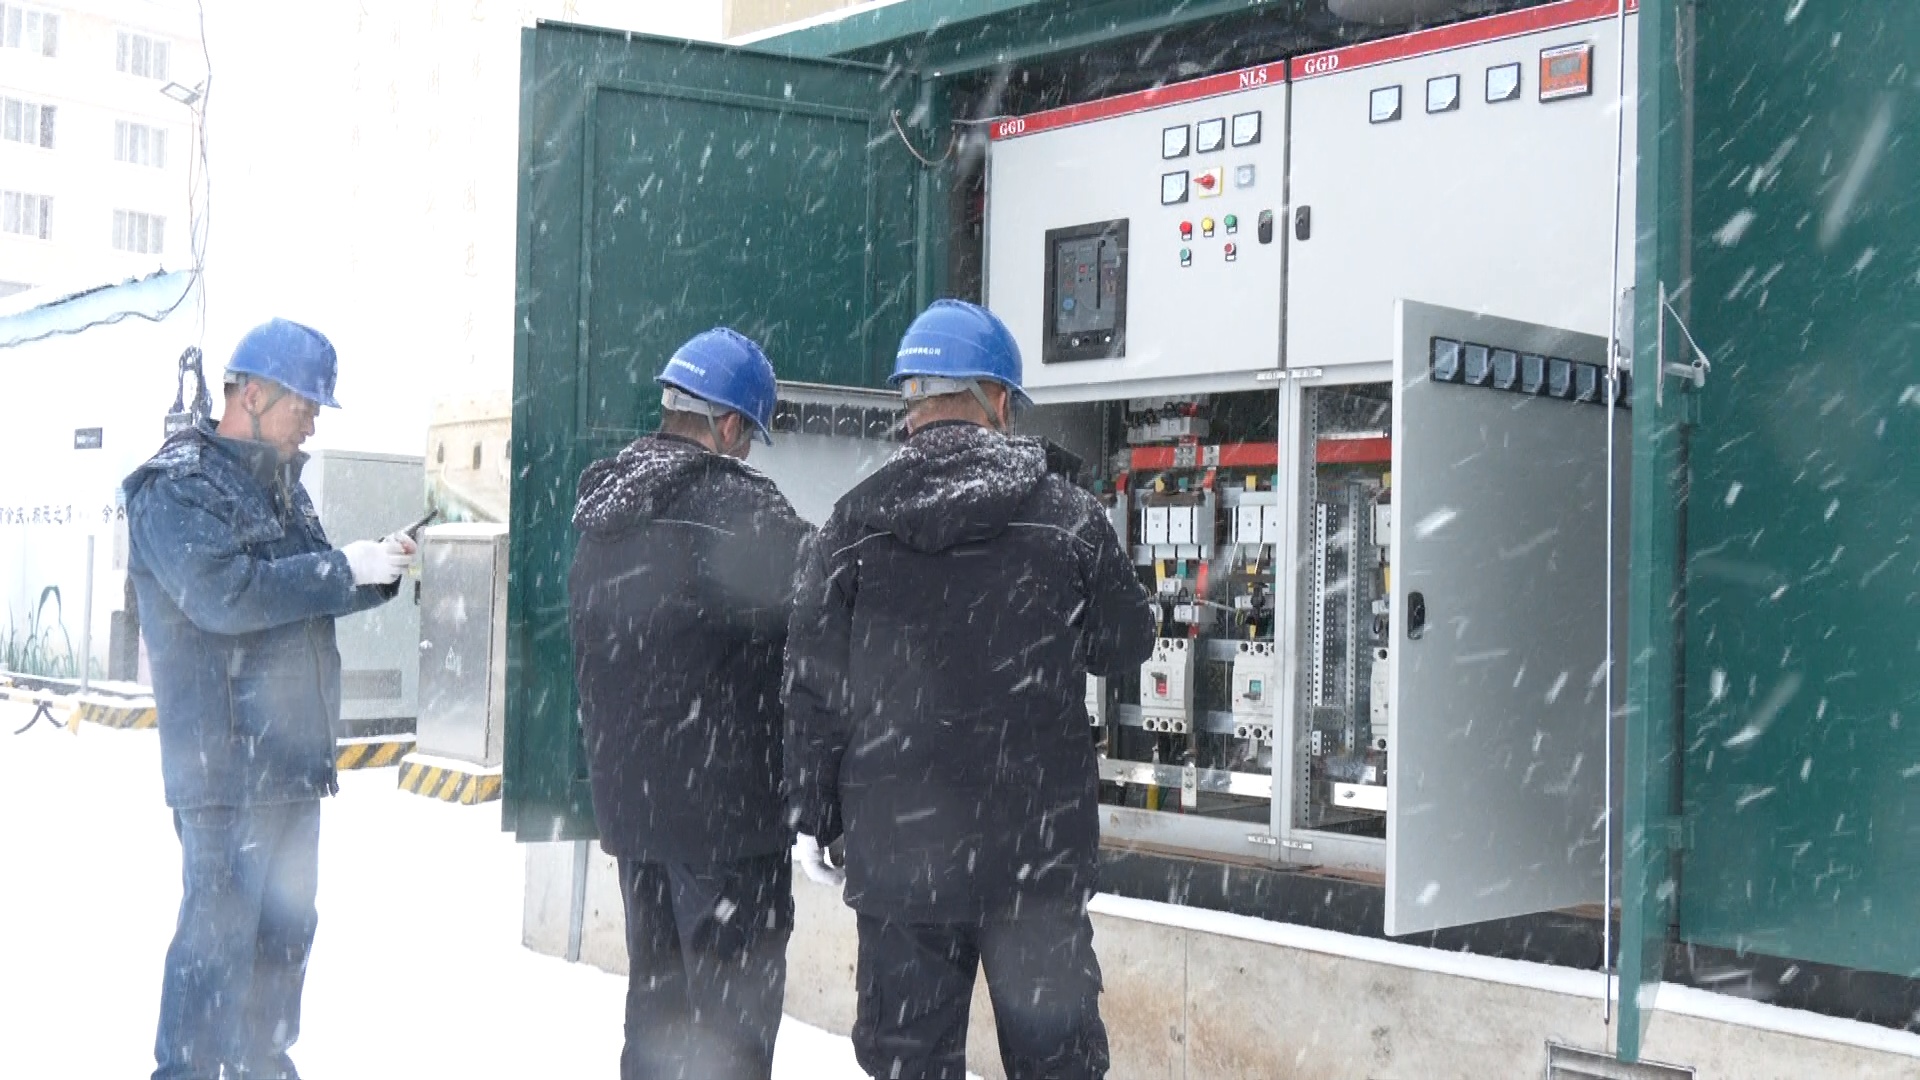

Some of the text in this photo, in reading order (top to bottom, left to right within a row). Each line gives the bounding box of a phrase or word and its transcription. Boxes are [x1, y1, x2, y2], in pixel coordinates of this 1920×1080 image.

[1304, 55, 1339, 74] GGD
[1239, 68, 1267, 88] NLS
[1000, 119, 1025, 136] GGD
